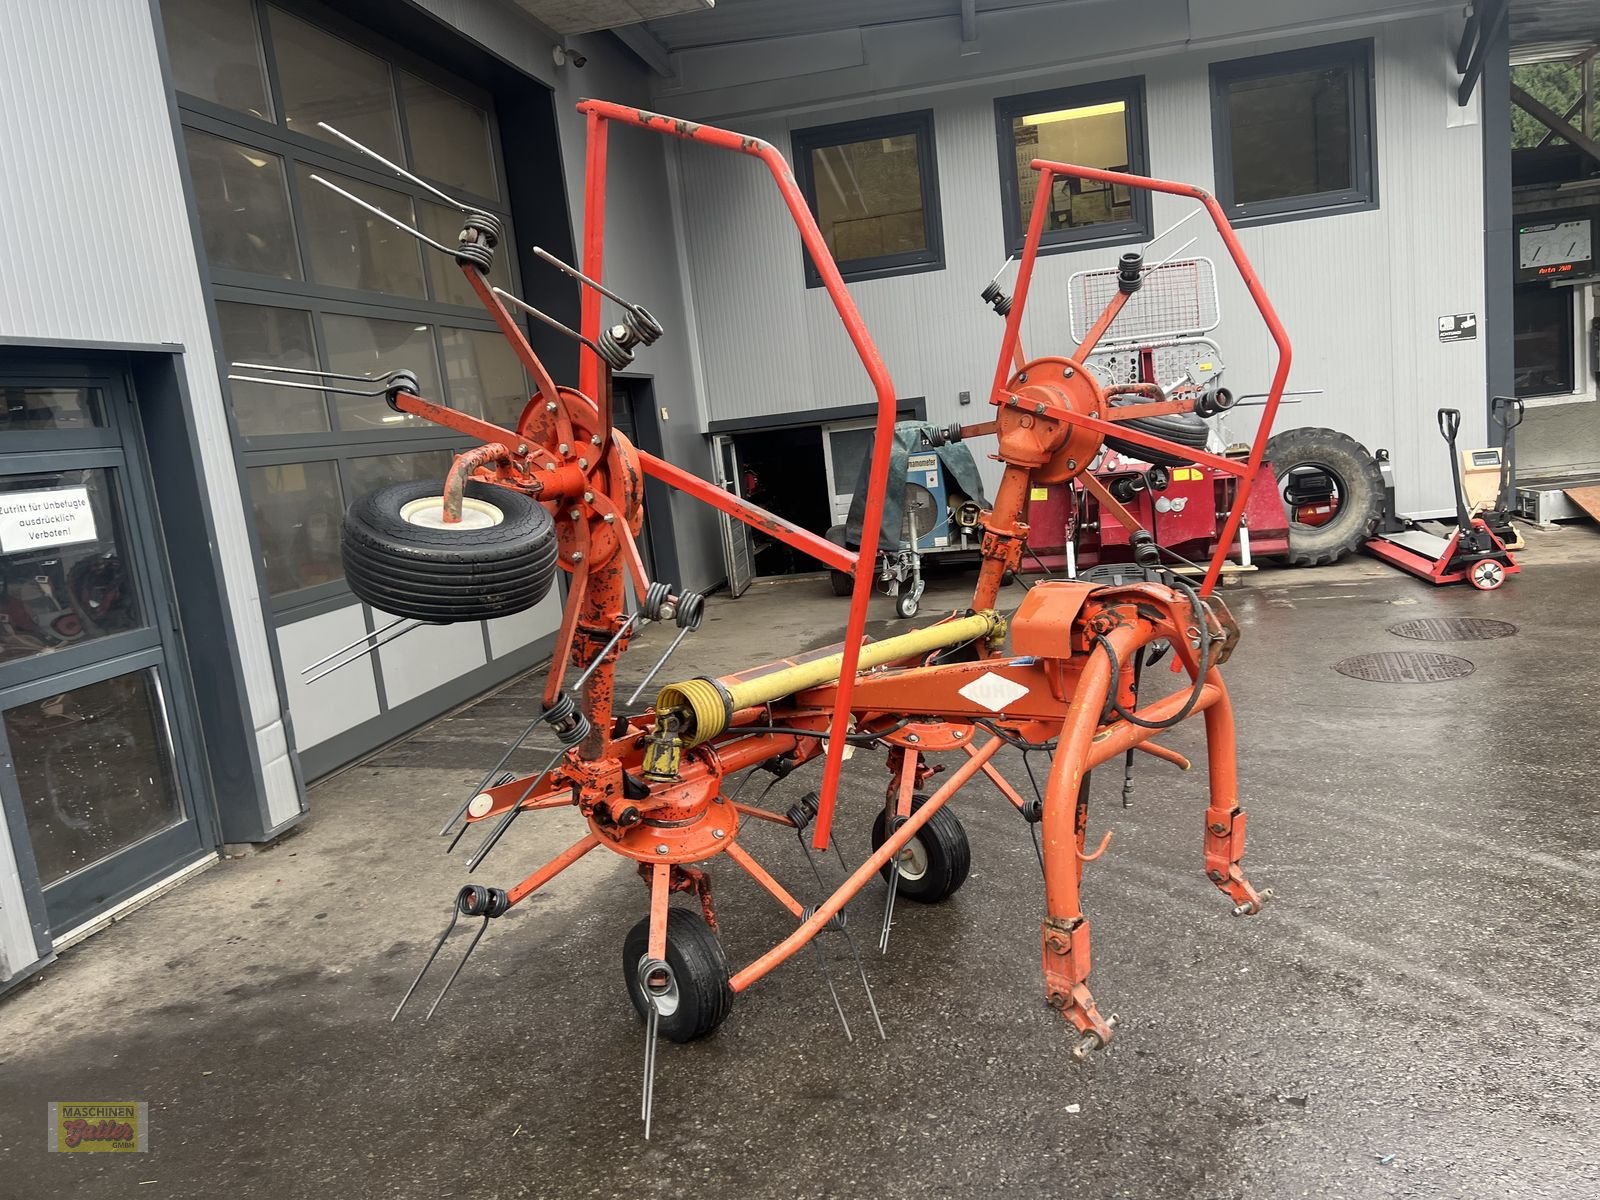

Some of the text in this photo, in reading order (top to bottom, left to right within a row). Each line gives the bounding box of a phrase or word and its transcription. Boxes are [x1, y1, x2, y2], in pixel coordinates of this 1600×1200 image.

[28, 502, 41, 512] für
[43, 498, 86, 510] Unbefugte
[19, 512, 76, 527] ausdrücklich
[28, 528, 72, 540] Verboten!
